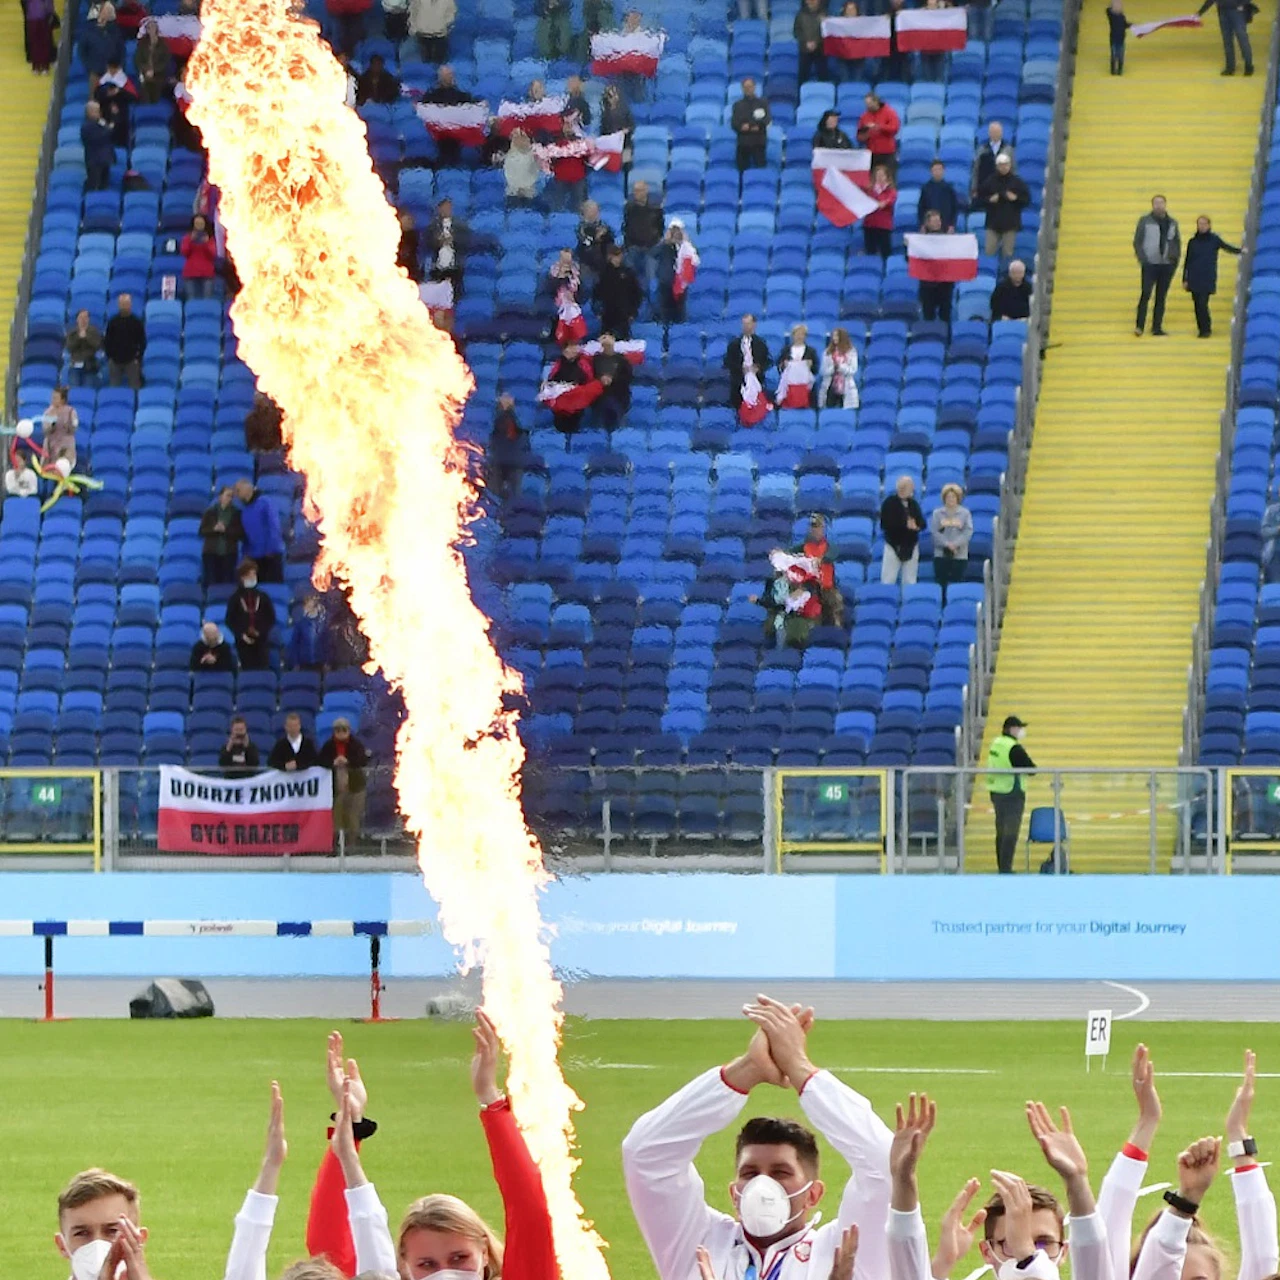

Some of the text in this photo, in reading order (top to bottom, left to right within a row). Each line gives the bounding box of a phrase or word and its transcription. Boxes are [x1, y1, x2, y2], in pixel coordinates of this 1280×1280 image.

[38, 786, 55, 802] 44
[250, 777, 320, 804] ZNOWU
[825, 784, 842, 800] 45
[233, 823, 299, 845] RAZEM
[931, 919, 1187, 937] Trusted partner for your Digital Journey
[1090, 1017, 1107, 1041] ER
